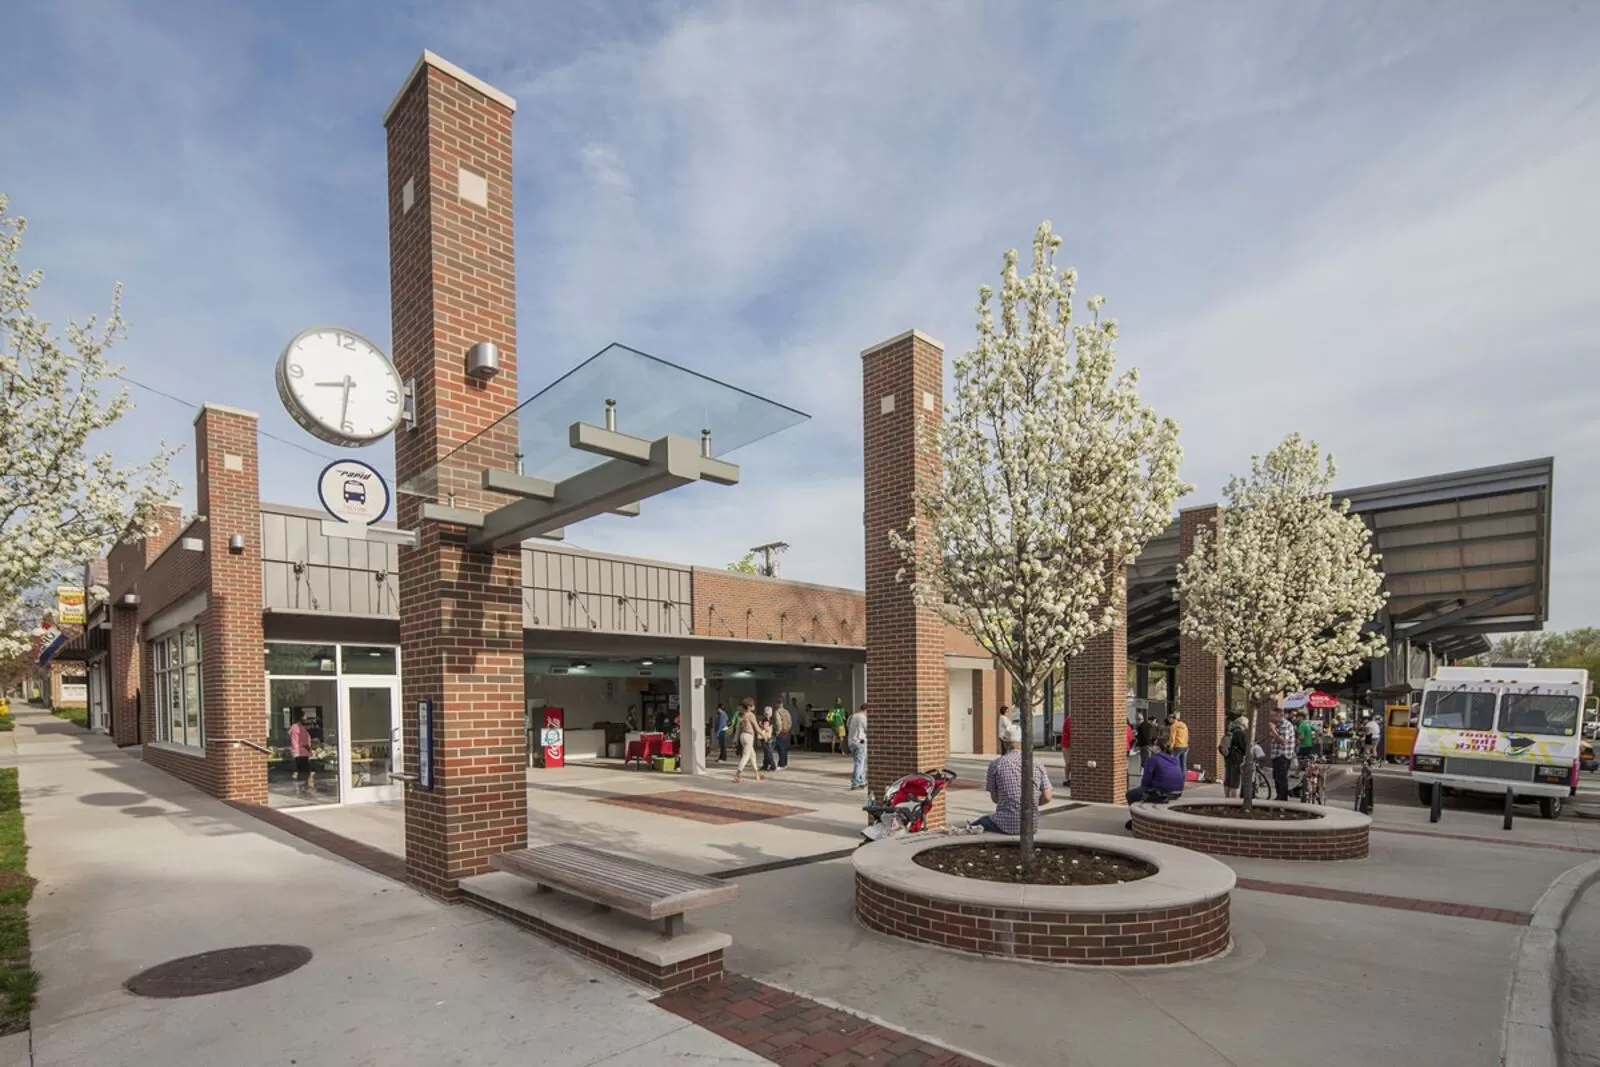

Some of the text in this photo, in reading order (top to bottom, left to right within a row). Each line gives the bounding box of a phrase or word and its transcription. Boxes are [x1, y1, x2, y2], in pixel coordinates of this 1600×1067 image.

[335, 333, 356, 351] 12
[289, 363, 304, 379] 9
[386, 390, 399, 405] 3
[341, 420, 354, 433] 6
[338, 470, 372, 480] rapid
